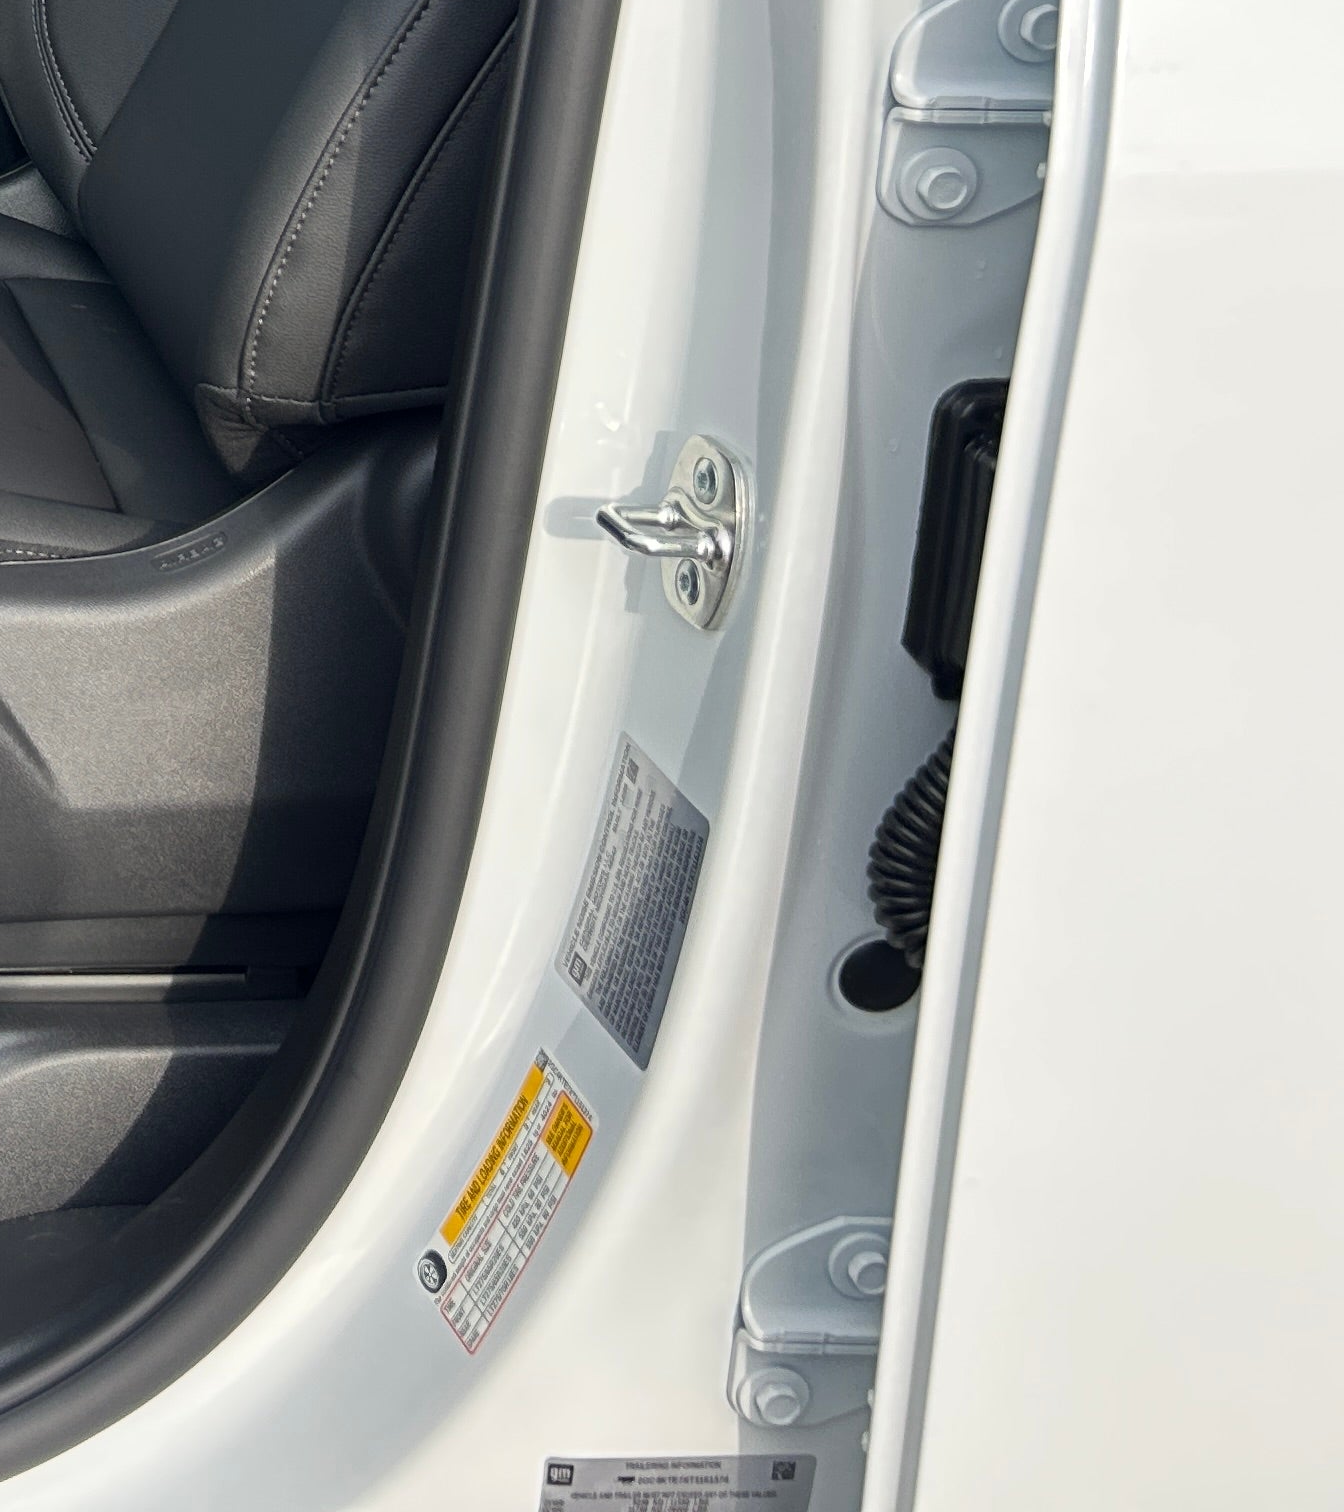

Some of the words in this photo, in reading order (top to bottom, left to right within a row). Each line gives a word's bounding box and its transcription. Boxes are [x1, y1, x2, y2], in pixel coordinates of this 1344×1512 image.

[455, 1197, 471, 1220] TIRE
[467, 1179, 481, 1200] AND
[476, 1145, 500, 1185] LOADING
[496, 1094, 529, 1149] INFORMATION
